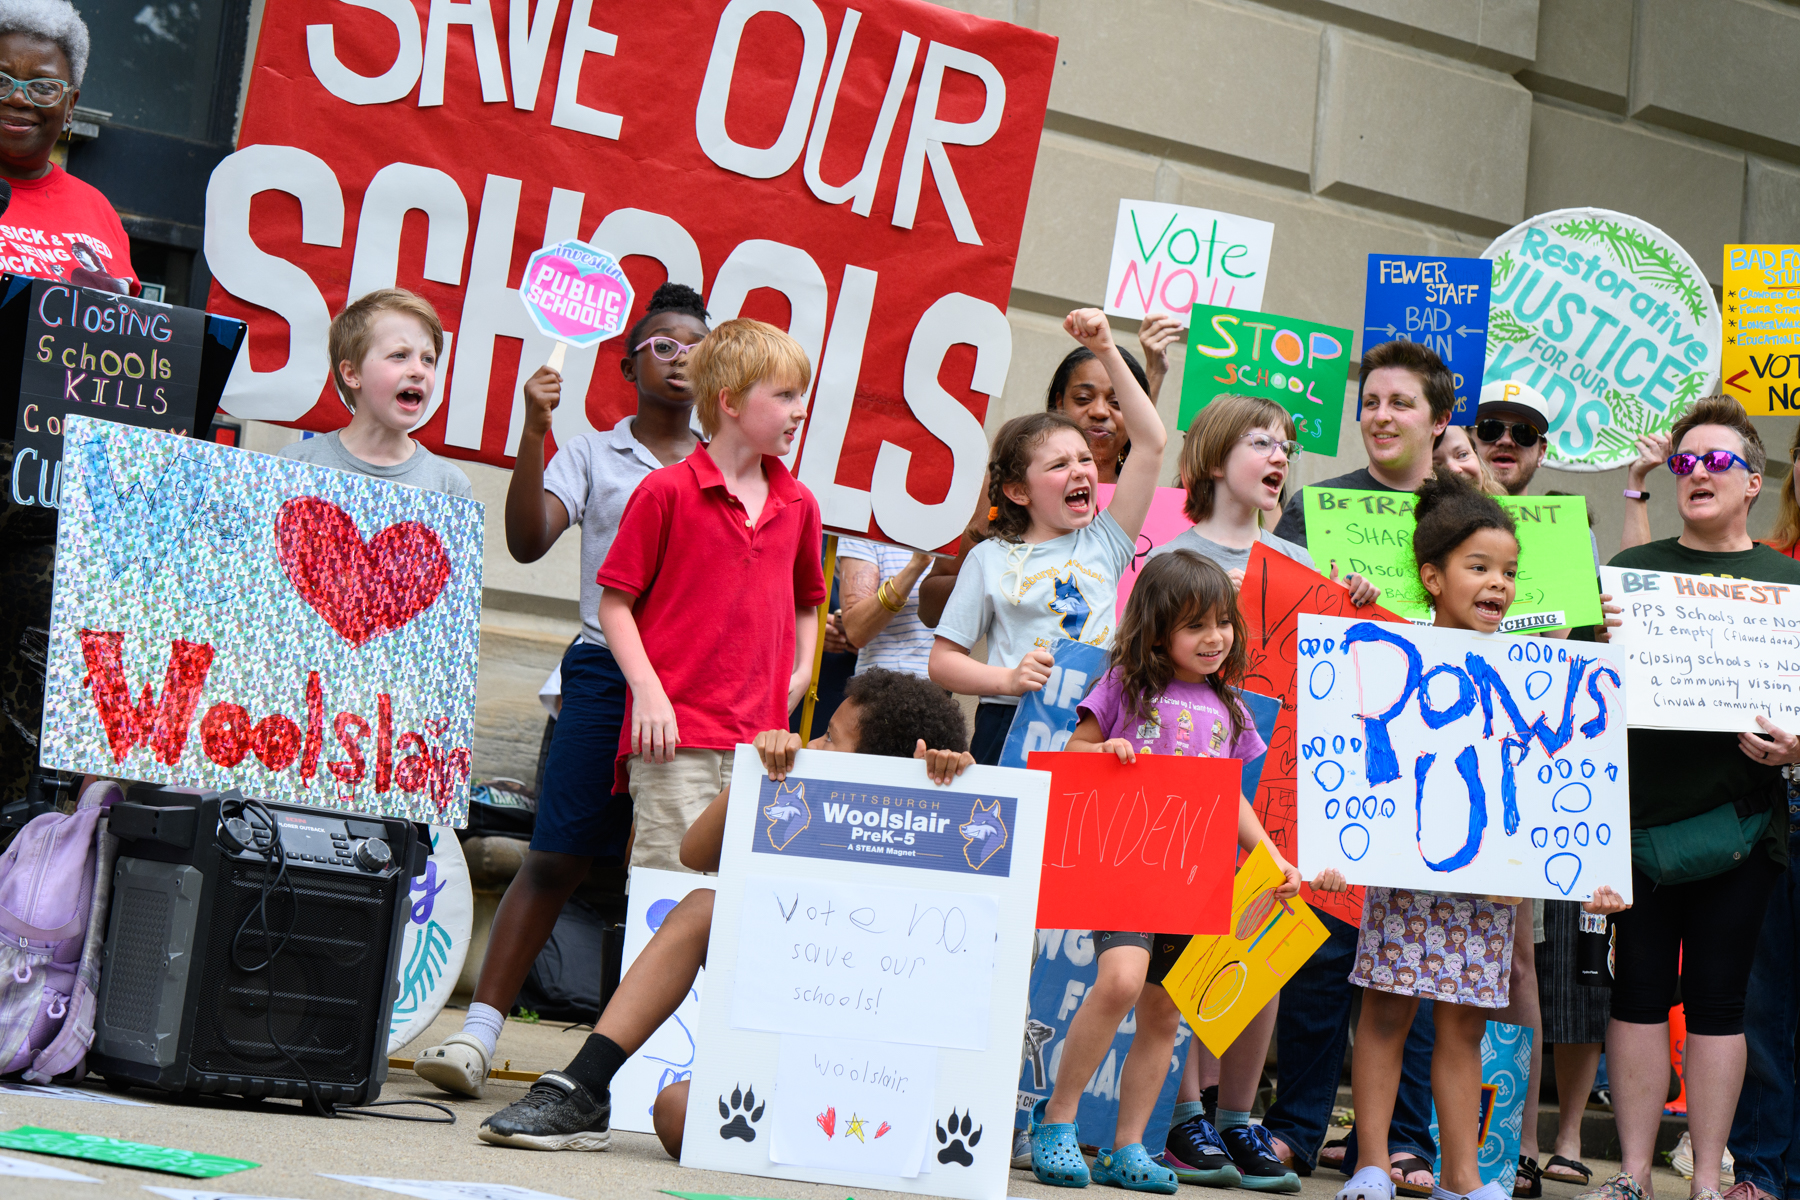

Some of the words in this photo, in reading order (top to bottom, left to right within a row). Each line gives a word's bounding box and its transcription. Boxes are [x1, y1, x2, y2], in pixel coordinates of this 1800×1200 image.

[307, 0, 623, 140] SAVE
[696, 0, 1006, 246] OUR
[0, 225, 50, 246] SICK
[1130, 209, 1256, 279] Vote
[555, 243, 606, 270] invest
[604, 262, 622, 281] in
[1379, 260, 1448, 285] FEWER
[1730, 248, 1776, 271] BAD
[534, 264, 622, 315] PUBLIC
[1425, 283, 1480, 305] STAFF
[1518, 227, 1709, 367] Restorative
[526, 283, 620, 334] SCHOOLS
[1405, 306, 1452, 332] BAD
[204, 144, 1013, 552] SCHOOLS
[1196, 314, 1343, 369] STOP
[1490, 261, 1692, 414] JUSTICE
[1213, 363, 1324, 406] SCHOOL
[1528, 335, 1569, 371] FOR
[1569, 362, 1610, 398] OUR
[64, 368, 168, 416] KILLS
[1502, 383, 1521, 402] P
[1620, 571, 1661, 594] BE
[1672, 575, 1791, 606] HONEST
[1632, 602, 1666, 618] PPS
[1675, 605, 1735, 625] Schools
[1743, 616, 1769, 626] are
[1669, 625, 1714, 649] empty
[1639, 651, 1693, 676] Closing
[1697, 650, 1751, 668] schools
[1758, 659, 1770, 669] is
[1651, 675, 1662, 687] a
[1670, 675, 1740, 700] community
[1747, 678, 1792, 693] vision
[1712, 697, 1772, 719] community
[822, 802, 951, 834] Woolslair
[830, 791, 941, 810] PITTSBURGH
[1414, 732, 1531, 874] UP
[846, 843, 855, 851] A
[855, 844, 884, 854] STEAM
[885, 847, 917, 858] Magnet
[774, 892, 888, 934] Vote
[791, 942, 856, 969] save
[880, 955, 926, 979] our
[793, 985, 883, 1015] schools!
